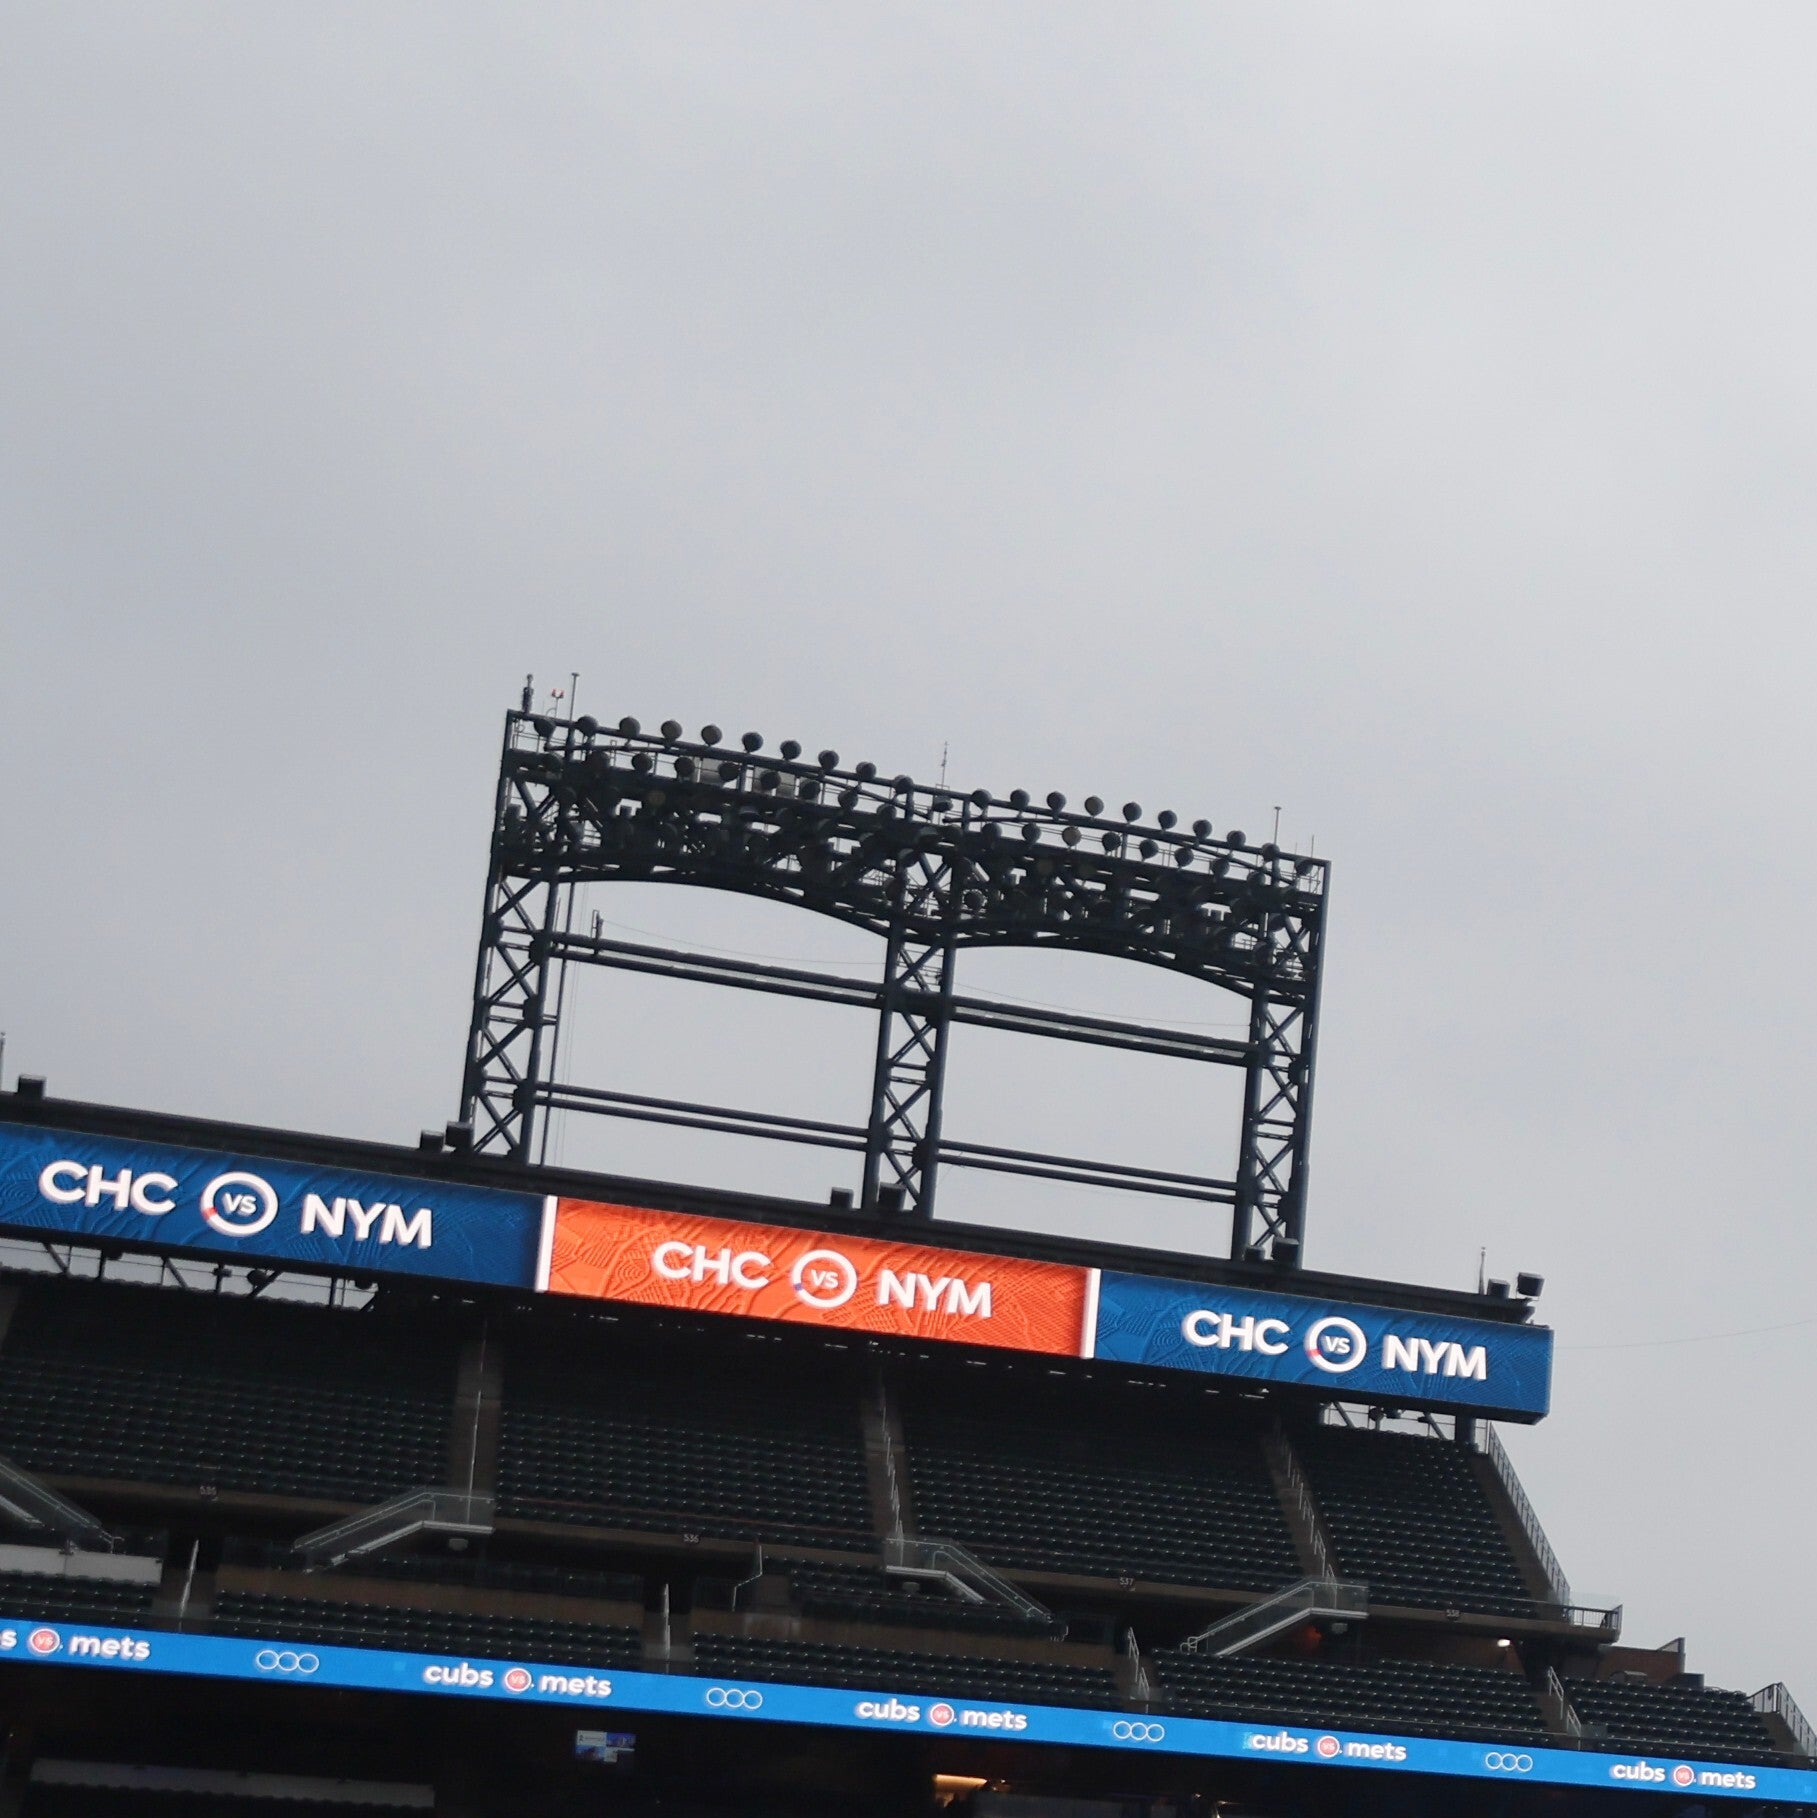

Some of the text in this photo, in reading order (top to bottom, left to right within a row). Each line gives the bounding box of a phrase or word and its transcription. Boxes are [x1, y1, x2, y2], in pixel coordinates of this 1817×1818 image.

[38, 1160, 433, 1249] CHC NYM
[652, 1242, 993, 1319] CHC NYM
[1182, 1310, 1487, 1381] CHC NYM
[69, 1632, 150, 1661] mets
[424, 1661, 611, 1698] cubs mets
[856, 1698, 1027, 1731] cubs mets
[1252, 1731, 1406, 1762] cubs mets
[1610, 1761, 1756, 1789] cubs mets
